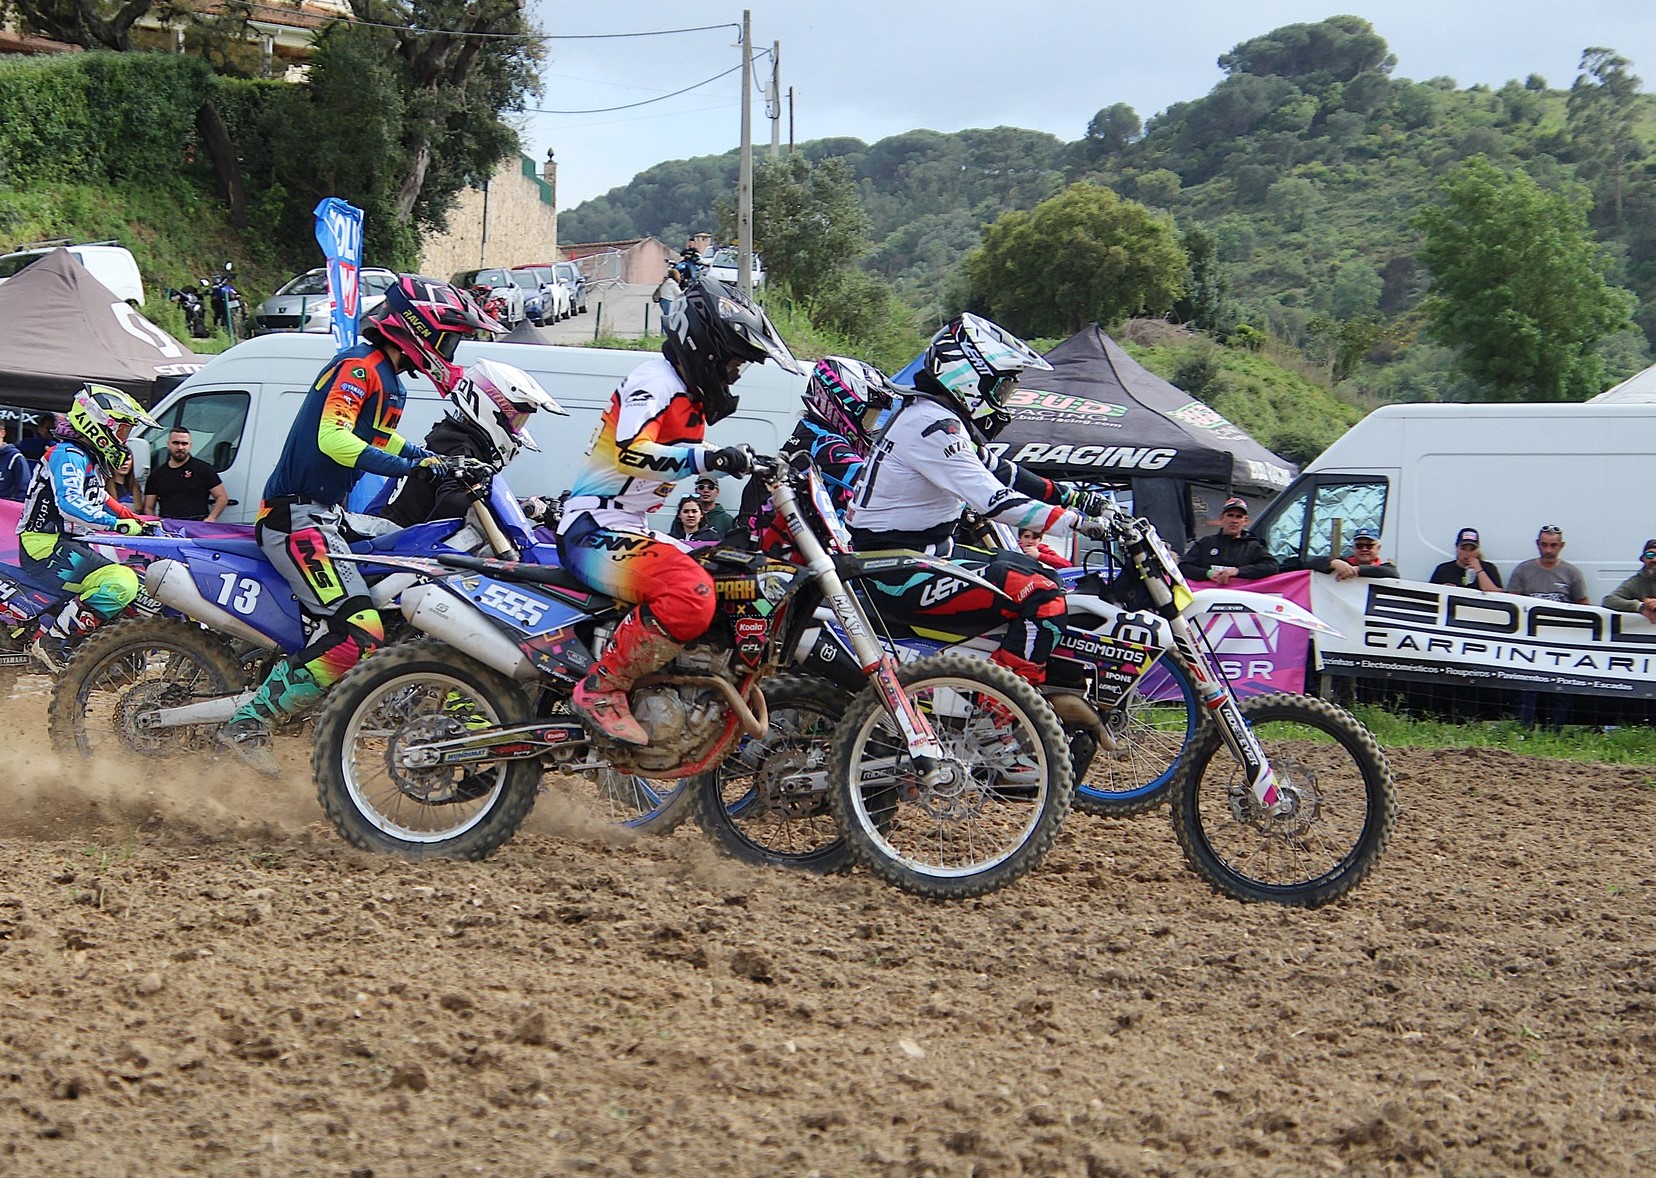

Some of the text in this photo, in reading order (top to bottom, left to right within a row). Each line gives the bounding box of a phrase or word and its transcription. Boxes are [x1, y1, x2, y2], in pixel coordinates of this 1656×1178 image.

[402, 309, 432, 338] RAVEN
[1012, 442, 1178, 471] RACING
[295, 539, 334, 589] IMS
[216, 572, 261, 615] 13
[479, 583, 549, 627] 555
[1016, 581, 1036, 602] LEATT
[739, 623, 763, 632] Koala
[741, 643, 760, 652] CFL
[1059, 635, 1145, 663] LUSOMOTOS
[1364, 631, 1650, 674] CARPINTARI
[1105, 671, 1133, 684] IPONE
[1205, 659, 1275, 681] SR
[1322, 658, 1634, 691] ozinhas Electrodomésticos Roupeiros Pavimentos Portas Escadas
